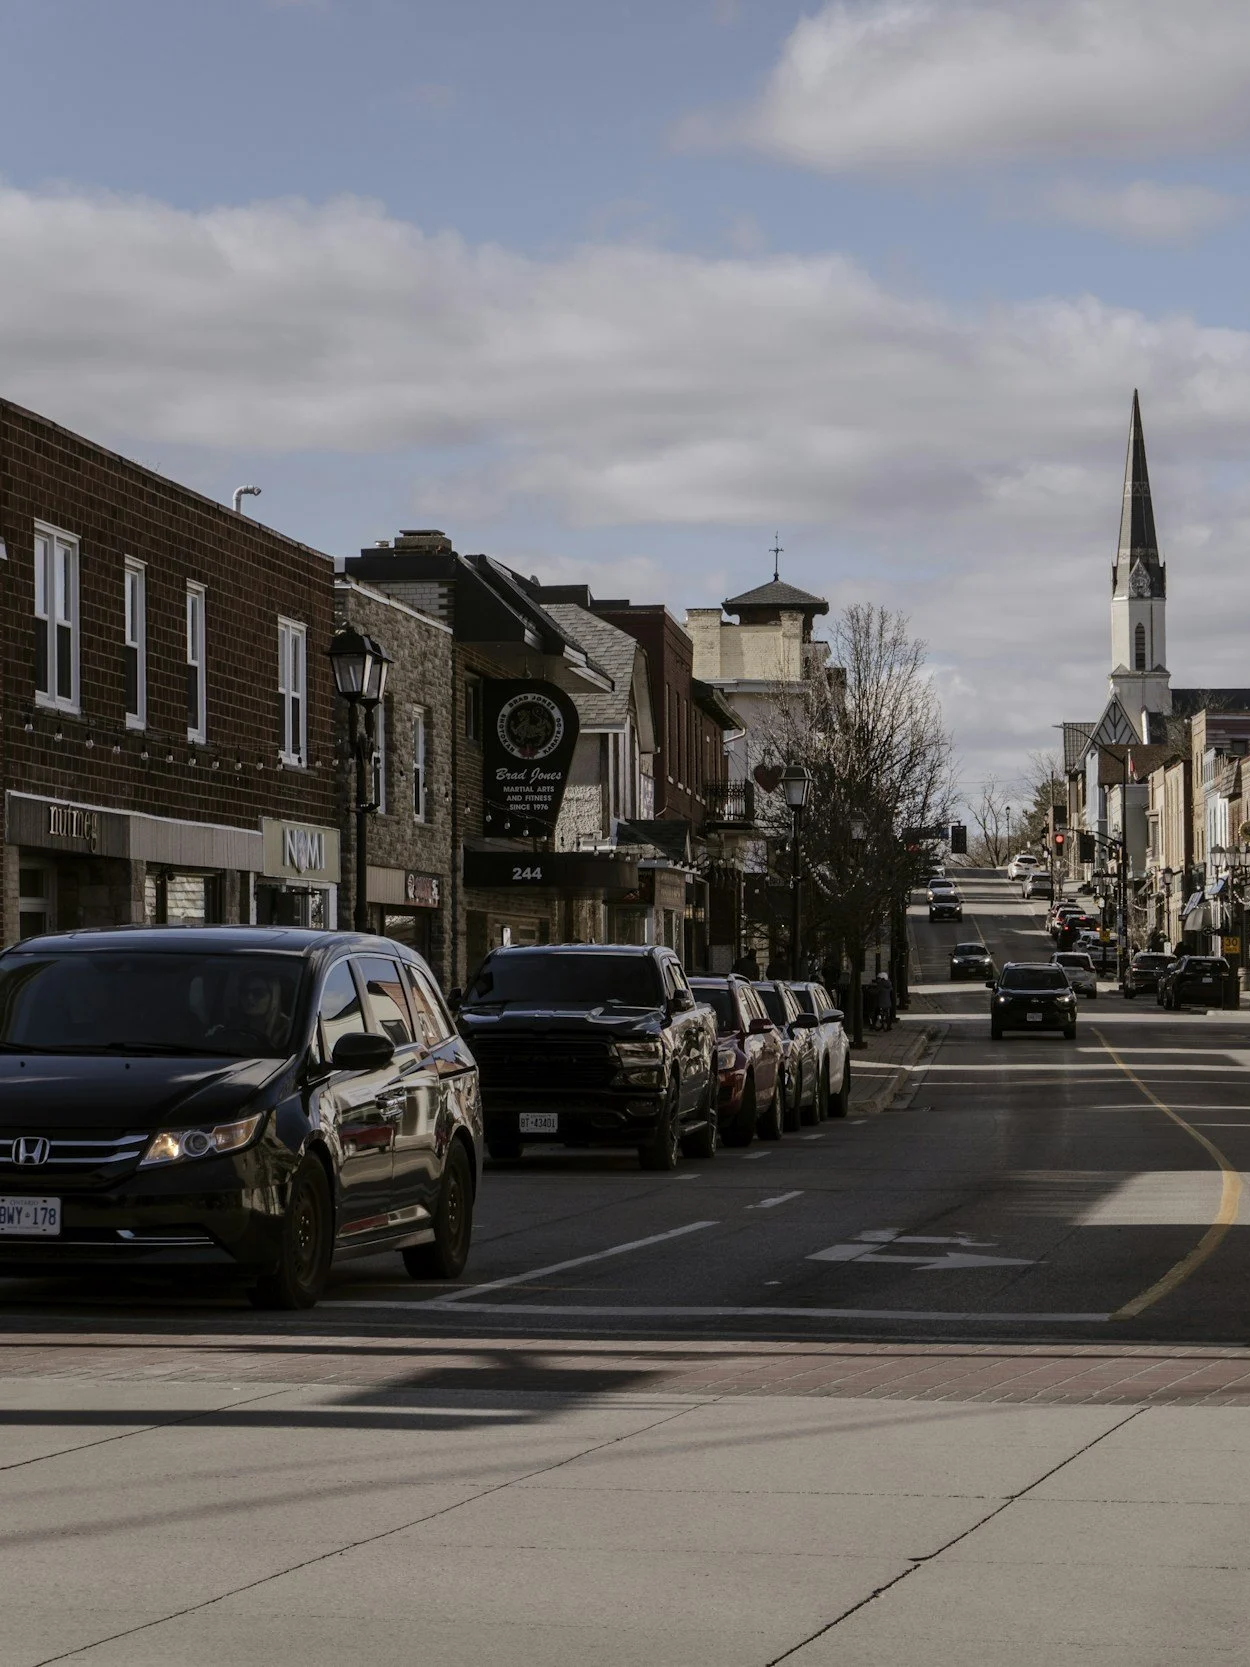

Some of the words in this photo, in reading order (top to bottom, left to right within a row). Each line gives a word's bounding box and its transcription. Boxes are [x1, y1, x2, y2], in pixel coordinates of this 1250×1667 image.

[495, 767, 528, 780] Brad
[529, 767, 562, 784] Jones
[503, 785, 534, 793] MARTIAL
[536, 785, 555, 793] ARTS
[506, 794, 523, 802] AND
[525, 794, 552, 802] FITNESS
[509, 803, 531, 811] SINCE
[533, 803, 549, 811] 1976
[49, 804, 98, 853] nutmeg
[512, 867, 542, 880] 244
[1225, 938, 1238, 947] 30
[32, 1207, 57, 1225] 178
